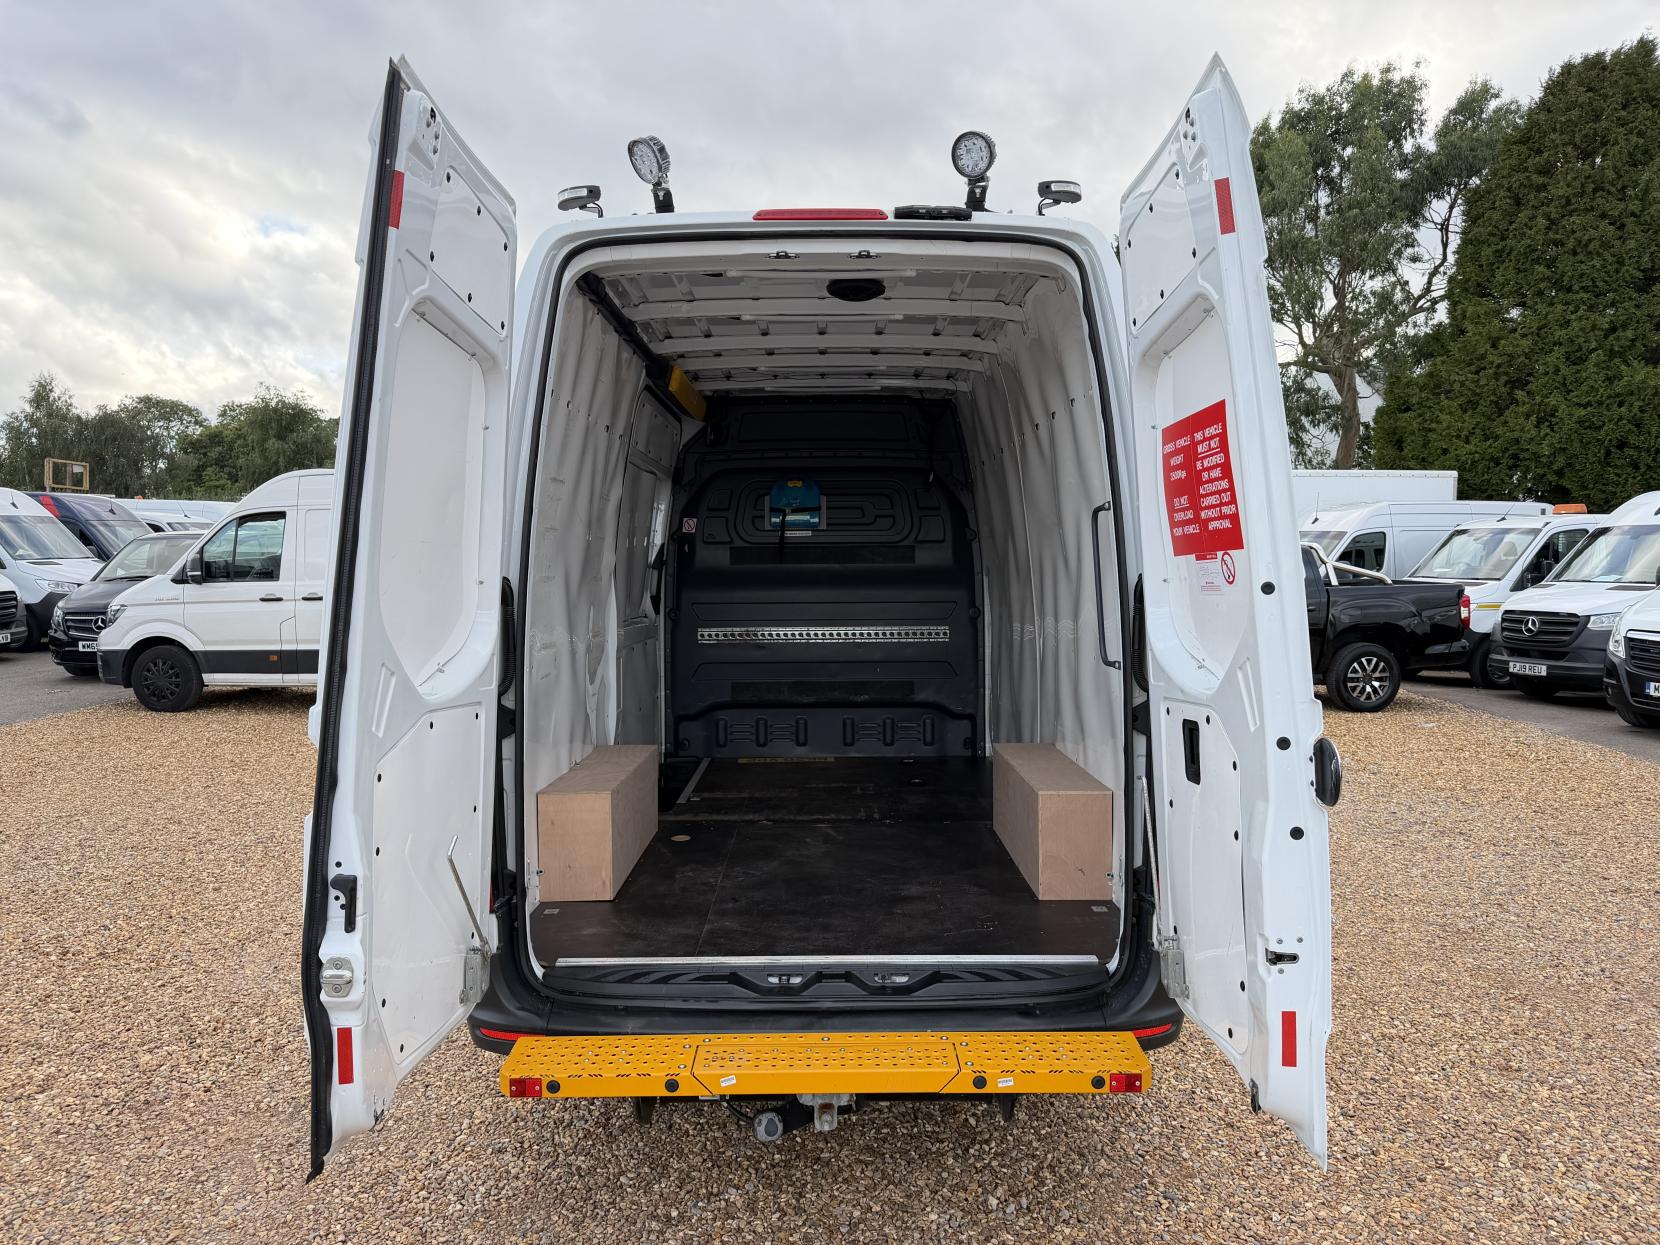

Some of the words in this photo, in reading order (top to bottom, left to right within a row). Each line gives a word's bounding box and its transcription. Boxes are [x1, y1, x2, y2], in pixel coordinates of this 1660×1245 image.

[1193, 430, 1203, 442] THIS
[1203, 422, 1222, 438] VEHICLE
[1163, 441, 1176, 454] GROSS
[1175, 435, 1190, 449] VEHICLE
[1197, 441, 1210, 453] MUST
[1210, 437, 1220, 449] NOT
[1170, 454, 1184, 466] WEIGHT
[1196, 460, 1203, 470] BE
[1203, 453, 1225, 468] MODIFIED
[1201, 471, 1209, 481] OR
[1209, 467, 1222, 479] HAVE
[1200, 479, 1229, 495] ALTERATIONS
[1173, 497, 1180, 507] DO
[1180, 495, 1189, 505] NOT
[1200, 494, 1220, 507] CARRIED
[1220, 492, 1231, 503] OUT
[1173, 509, 1194, 521] OVERLOAD
[1200, 507, 1220, 519] WITHOUT
[1220, 504, 1237, 516] PRIOR
[1173, 526, 1183, 536] YOUR
[1183, 523, 1200, 534] VEHICLE
[1208, 518, 1232, 531] APPROVAL
[1512, 663, 1527, 673] PJ19
[1527, 665, 1543, 674] REU
